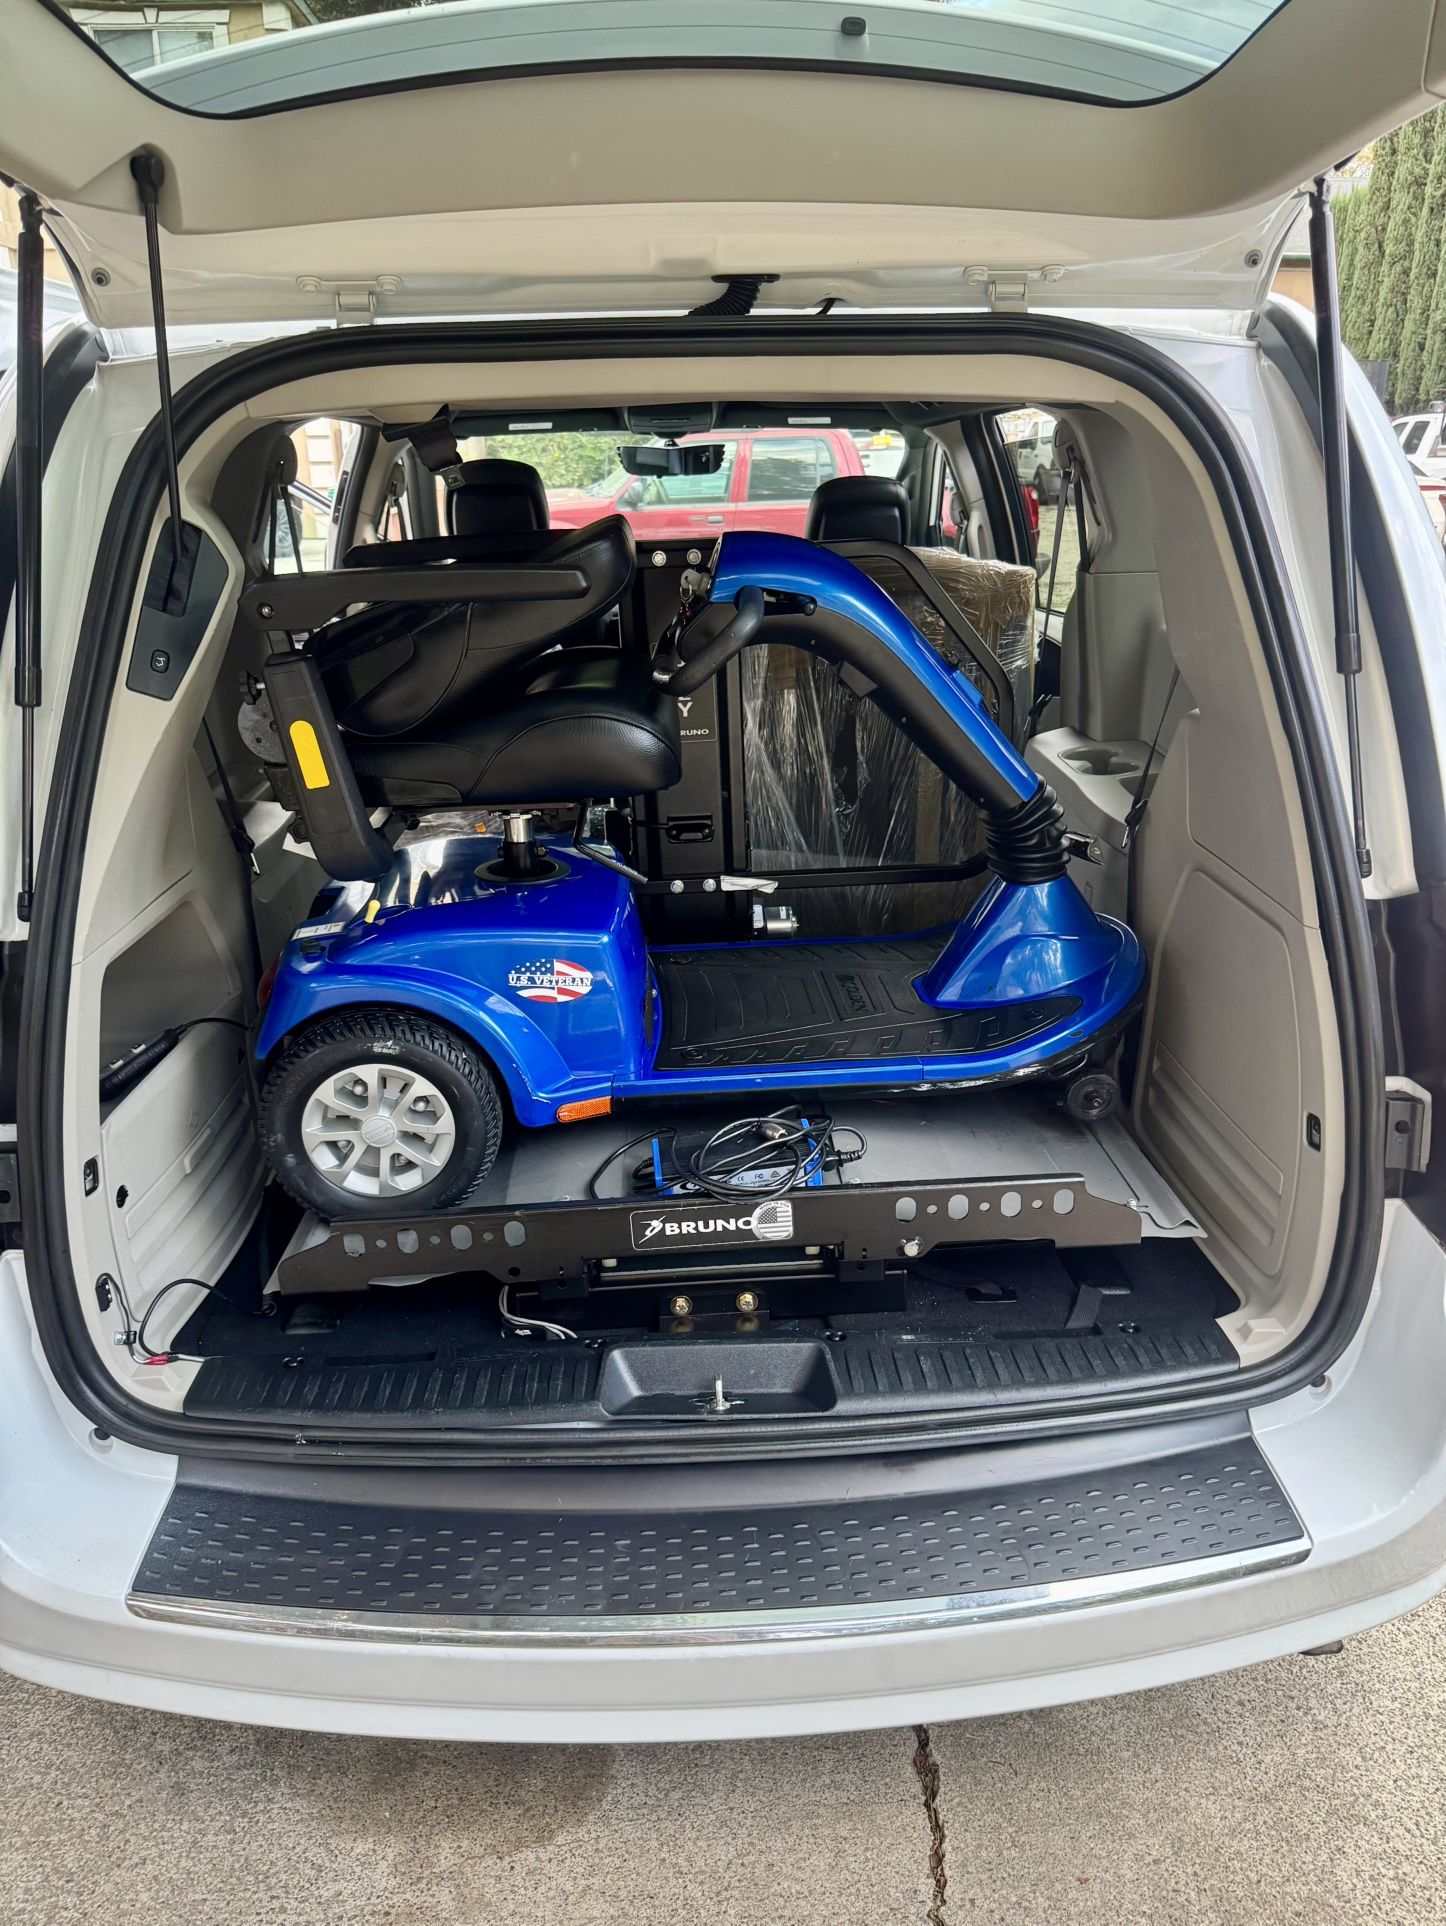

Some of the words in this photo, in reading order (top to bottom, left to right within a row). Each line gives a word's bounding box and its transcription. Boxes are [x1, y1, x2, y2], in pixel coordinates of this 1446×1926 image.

[680, 728, 709, 736] RUNO
[508, 974, 532, 987] U.S.
[534, 977, 592, 987] VETERAN
[664, 1216, 754, 1236] BRUNO
